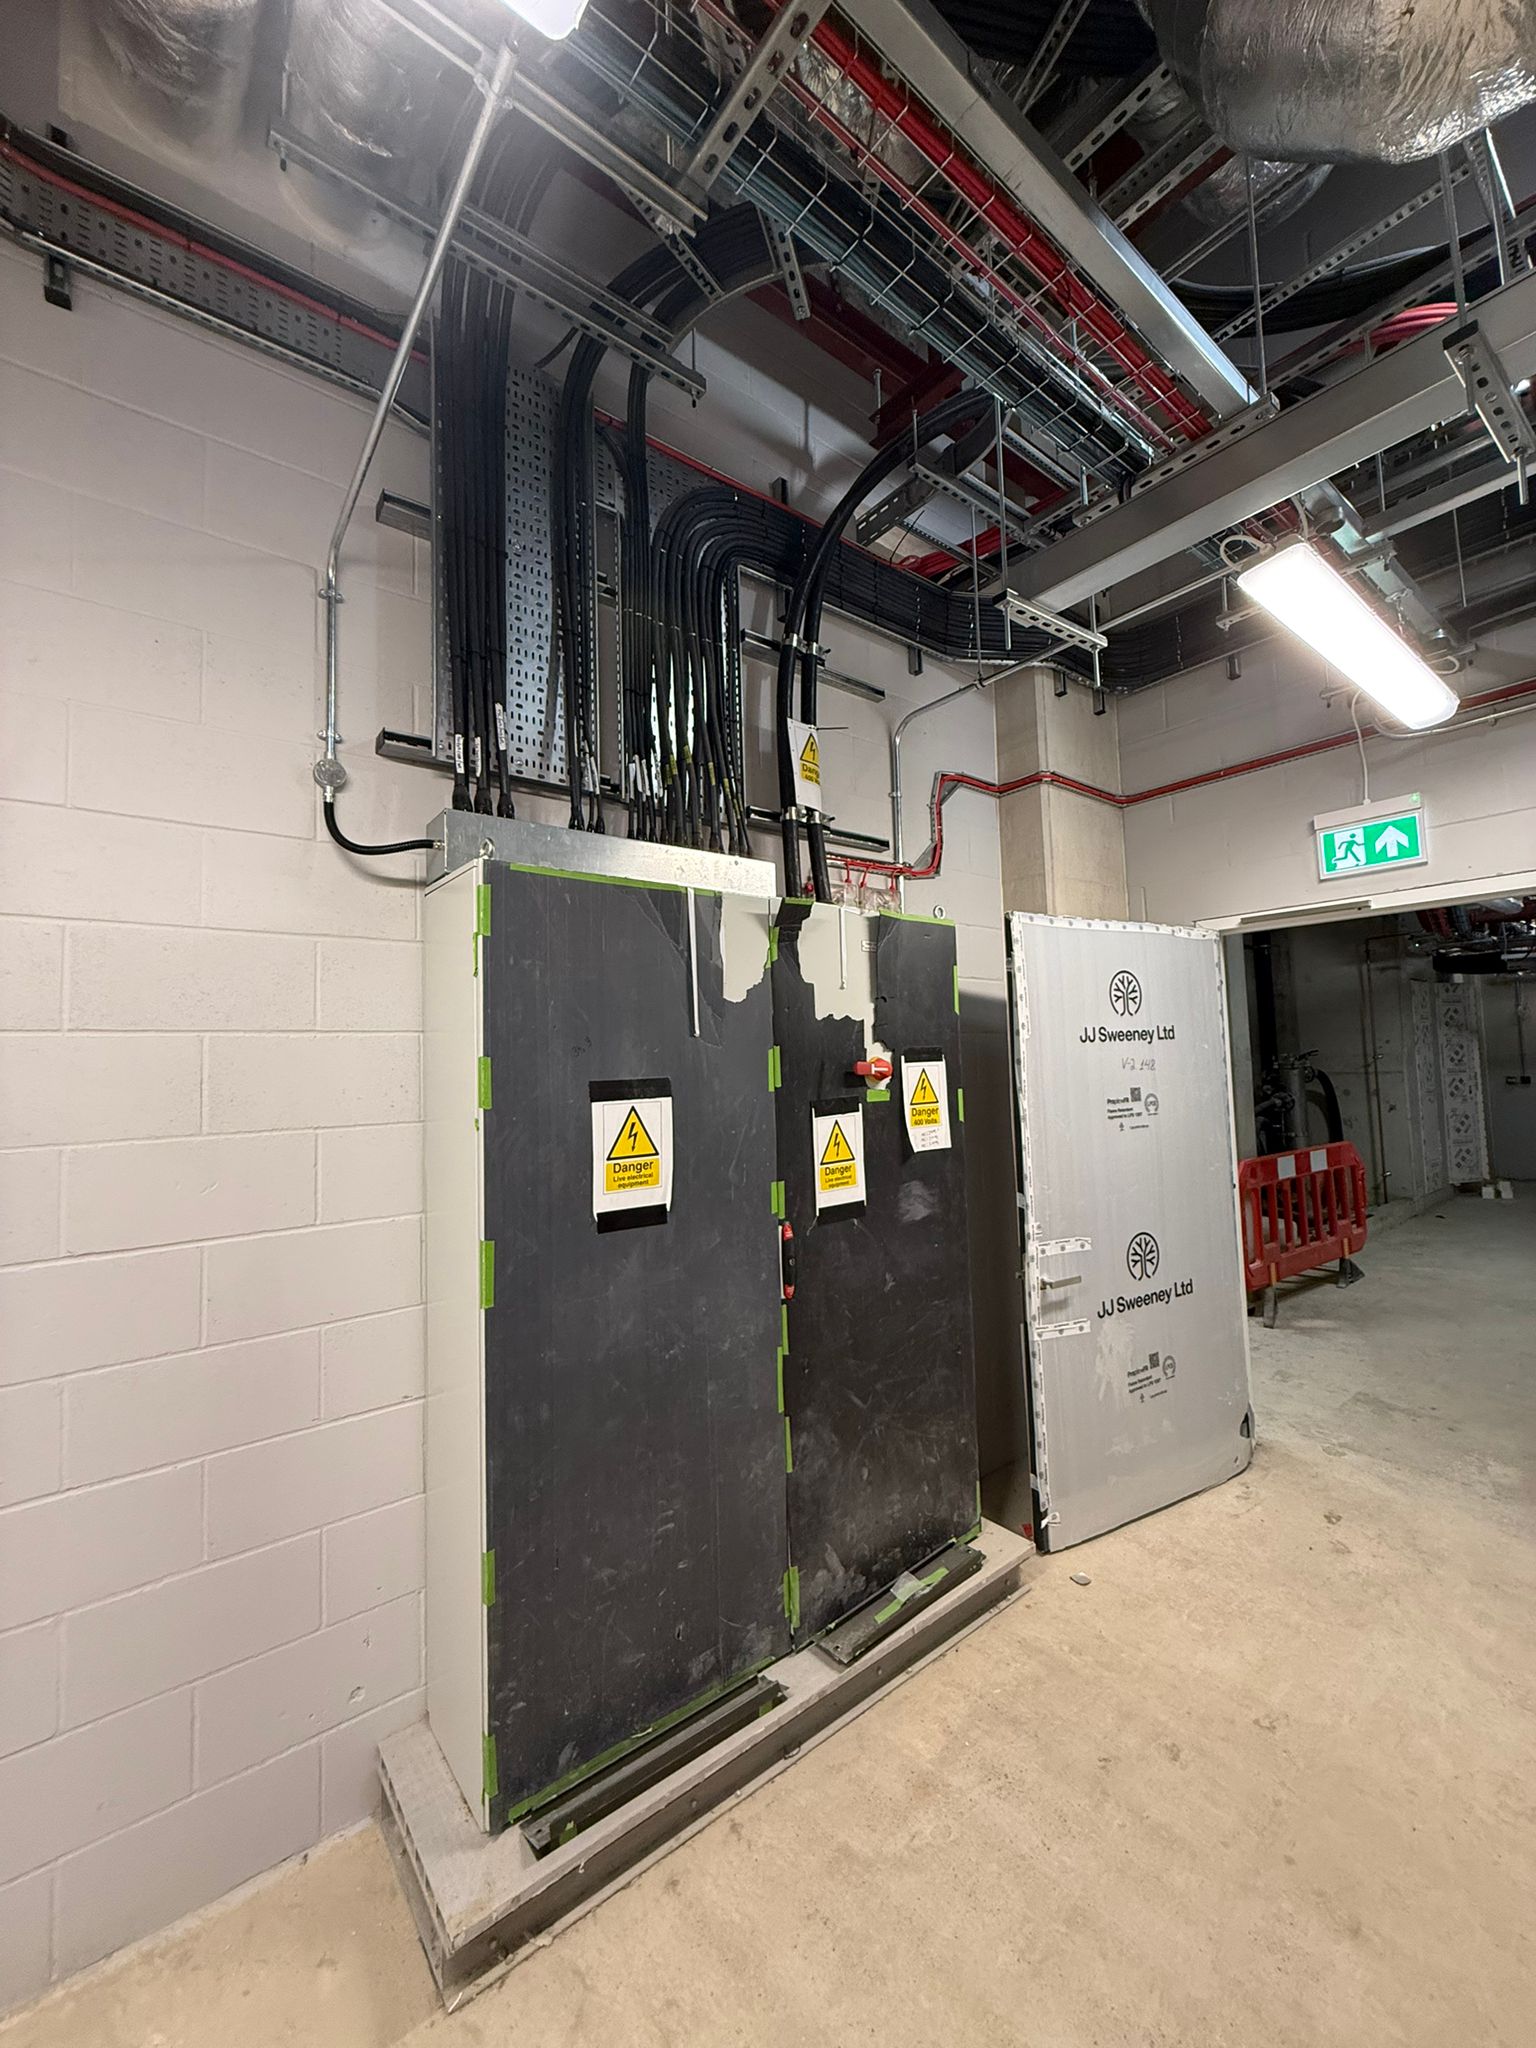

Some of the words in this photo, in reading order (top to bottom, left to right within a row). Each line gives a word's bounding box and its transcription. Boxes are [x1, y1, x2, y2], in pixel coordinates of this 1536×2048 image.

[1080, 1026, 1096, 1043] JJ
[1098, 1026, 1155, 1045] Sweeney
[1157, 1025, 1175, 1040] Ltd
[911, 1107, 939, 1117] Danger
[914, 1118, 924, 1126] 400
[613, 1161, 654, 1174] Danger
[825, 1165, 852, 1176] Danger
[627, 1172, 654, 1180] electrical
[618, 1179, 649, 1189] equipment
[1097, 1298, 1114, 1319] JJ
[1116, 1287, 1172, 1314] Sweeney
[1174, 1278, 1193, 1298] Ltd
